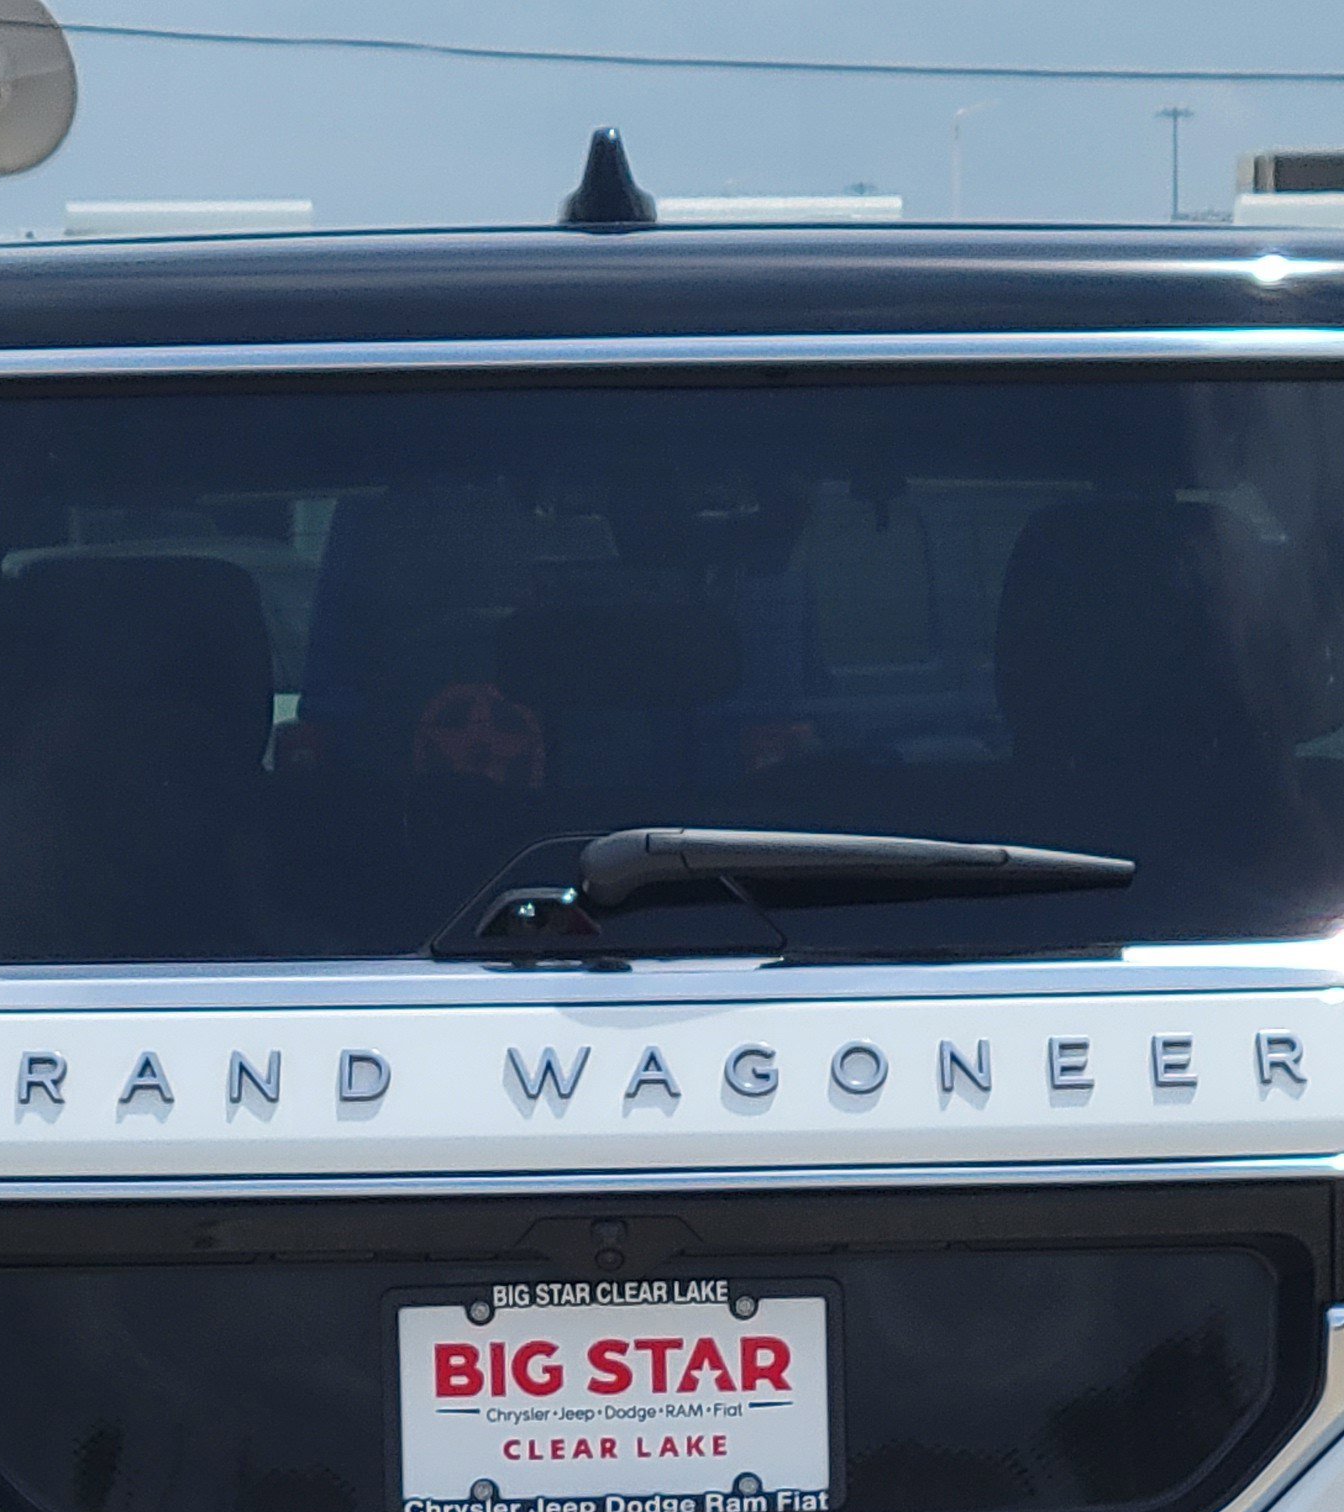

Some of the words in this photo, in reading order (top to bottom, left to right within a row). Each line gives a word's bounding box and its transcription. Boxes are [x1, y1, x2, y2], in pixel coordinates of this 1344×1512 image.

[506, 1028, 1309, 1100] WAGONEER
[493, 1284, 530, 1307] BIG
[535, 1282, 590, 1306] STAR
[596, 1281, 668, 1304] CLEAR
[673, 1280, 729, 1303] LAKE
[434, 1340, 564, 1397] BIG
[587, 1336, 792, 1395] STAR
[486, 1406, 550, 1425] Chrysler
[557, 1406, 595, 1422] Jeep
[604, 1404, 656, 1421] Dodge
[666, 1404, 705, 1418] RAM
[713, 1403, 743, 1417] Fiat
[503, 1439, 617, 1460] CLEAR
[637, 1435, 729, 1457] LAKE
[705, 1494, 768, 1512] Ram
[776, 1491, 830, 1512] Fiat
